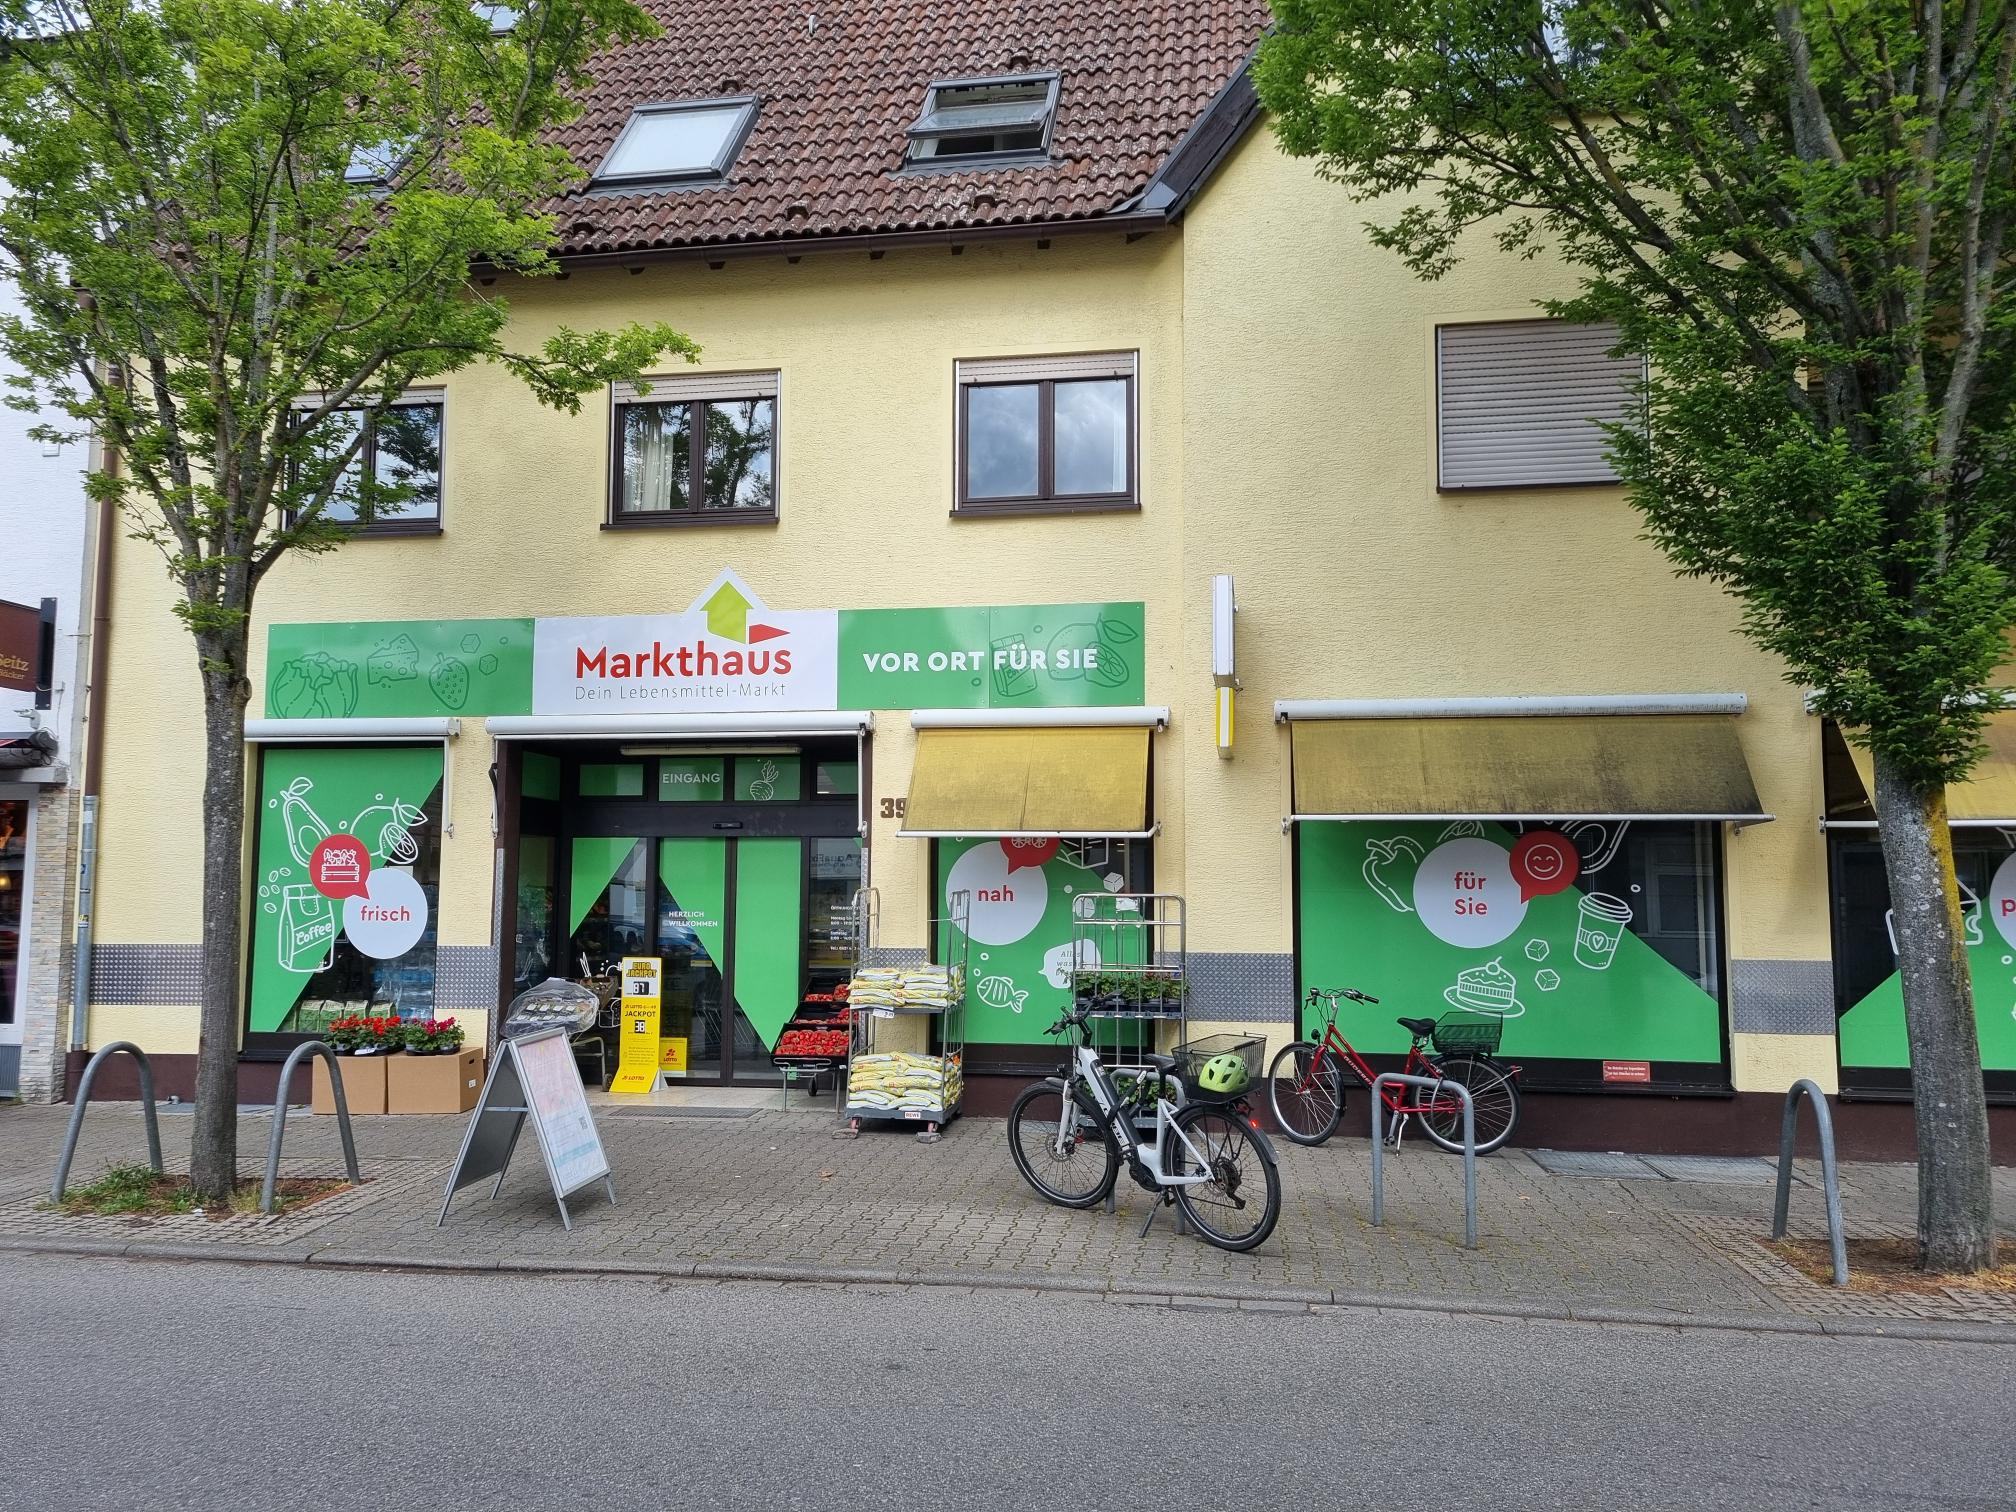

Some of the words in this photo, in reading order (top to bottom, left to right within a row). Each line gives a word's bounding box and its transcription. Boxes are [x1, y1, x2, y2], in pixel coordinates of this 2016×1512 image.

[576, 641, 792, 679] Markthaus
[862, 652, 920, 673] VOR
[927, 650, 985, 671] ORT
[993, 643, 1048, 671] FÜR
[1056, 648, 1098, 669] SIE
[575, 686, 612, 701] Dein
[619, 682, 786, 700] Lebensmittel-Markt
[662, 773, 721, 784] EINGANG
[1453, 871, 1487, 891] für
[977, 884, 1015, 903] nah
[361, 905, 411, 922] frisch
[1454, 898, 1488, 916] Sie
[295, 922, 333, 946] Coffee
[1060, 950, 1081, 958] Alls
[626, 969, 657, 978] JACKPOT
[632, 962, 651, 970] EURO
[624, 1010, 656, 1018] JACKPOT
